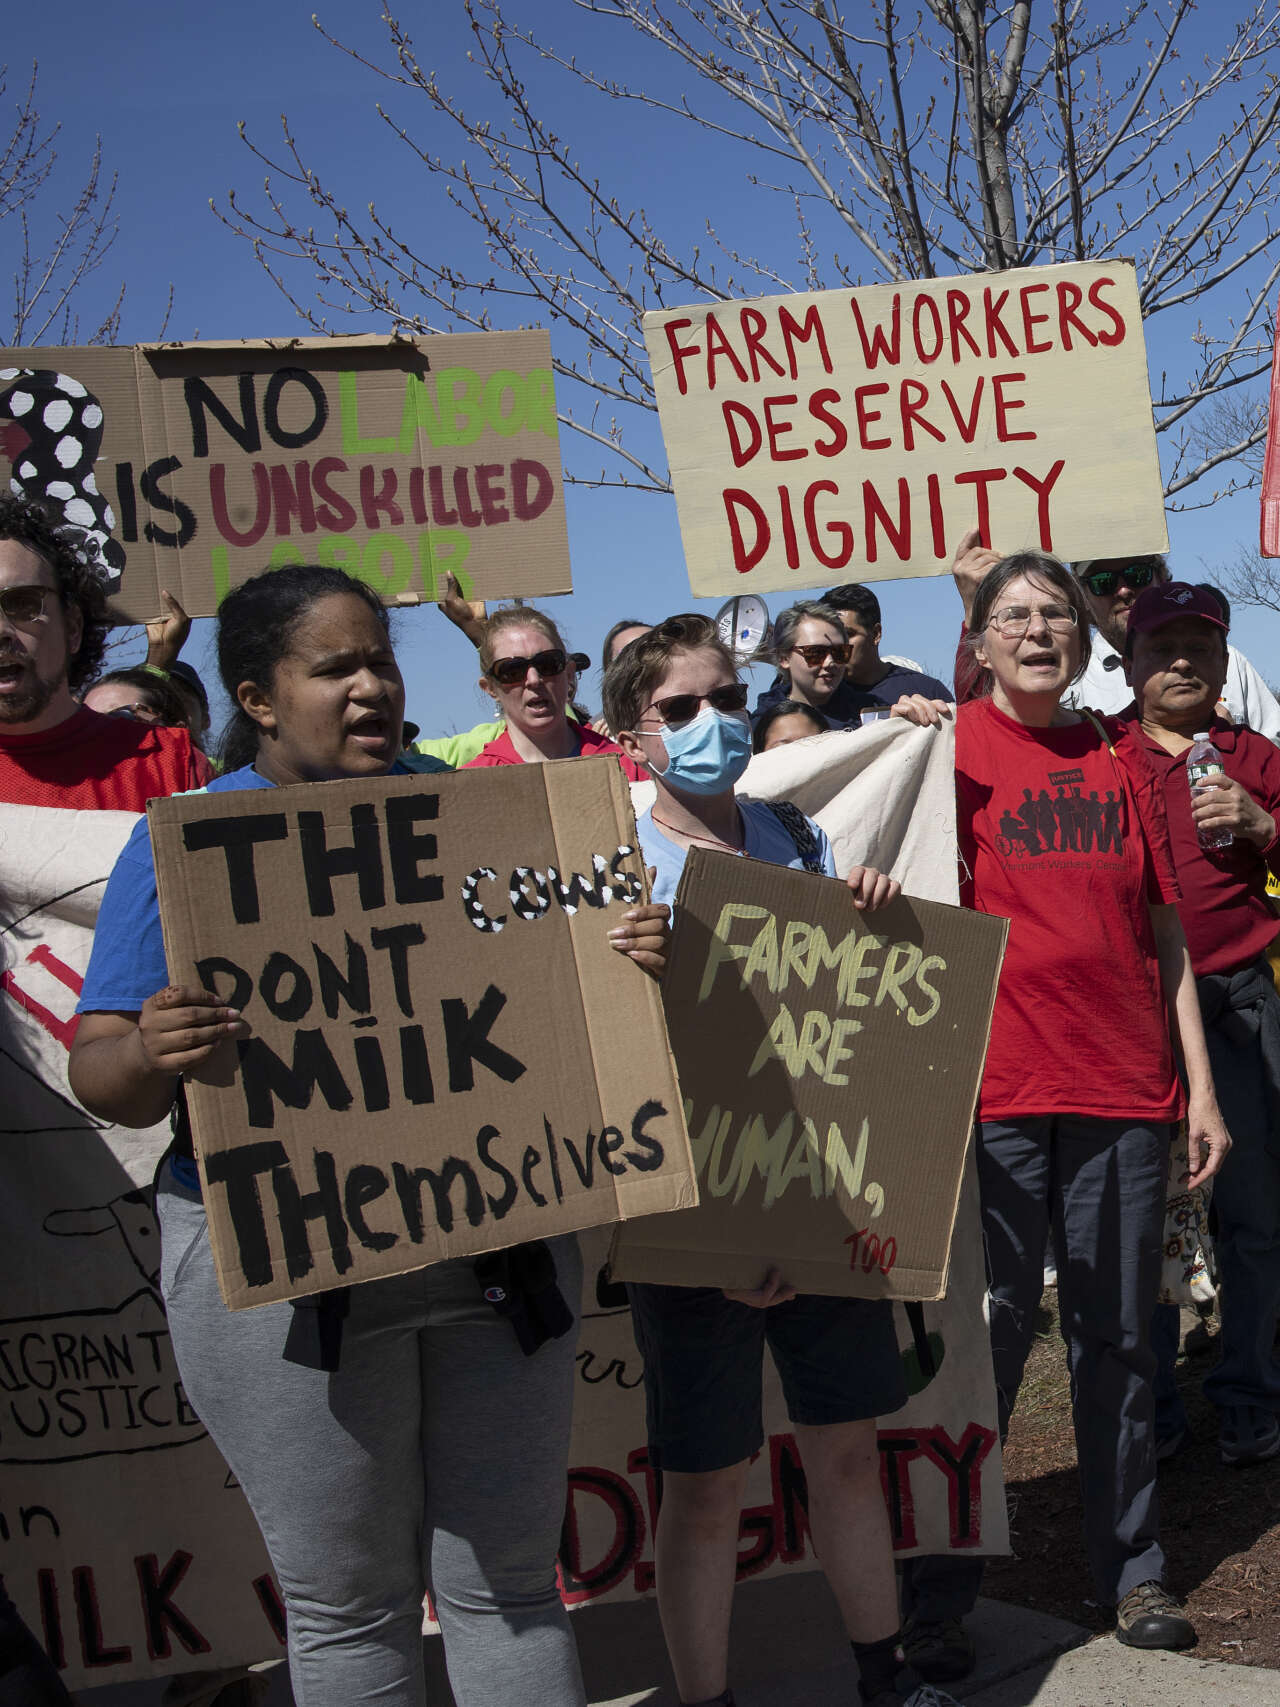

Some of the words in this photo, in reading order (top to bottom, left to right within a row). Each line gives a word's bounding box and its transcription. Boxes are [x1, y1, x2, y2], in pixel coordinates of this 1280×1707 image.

[664, 304, 834, 395] FARM
[851, 277, 1127, 370] WORKERS
[184, 367, 328, 457] NO
[722, 372, 1037, 468] DESERVE
[116, 456, 197, 547] IS
[210, 457, 555, 546] UNSKILLED
[722, 459, 1066, 574] DIGNITY
[182, 793, 445, 925] THE
[461, 844, 643, 933] COWS
[195, 923, 426, 1024] DONT
[699, 903, 947, 1026] FARMERS
[748, 1003, 865, 1086] ARE
[843, 1226, 897, 1276] TOO
